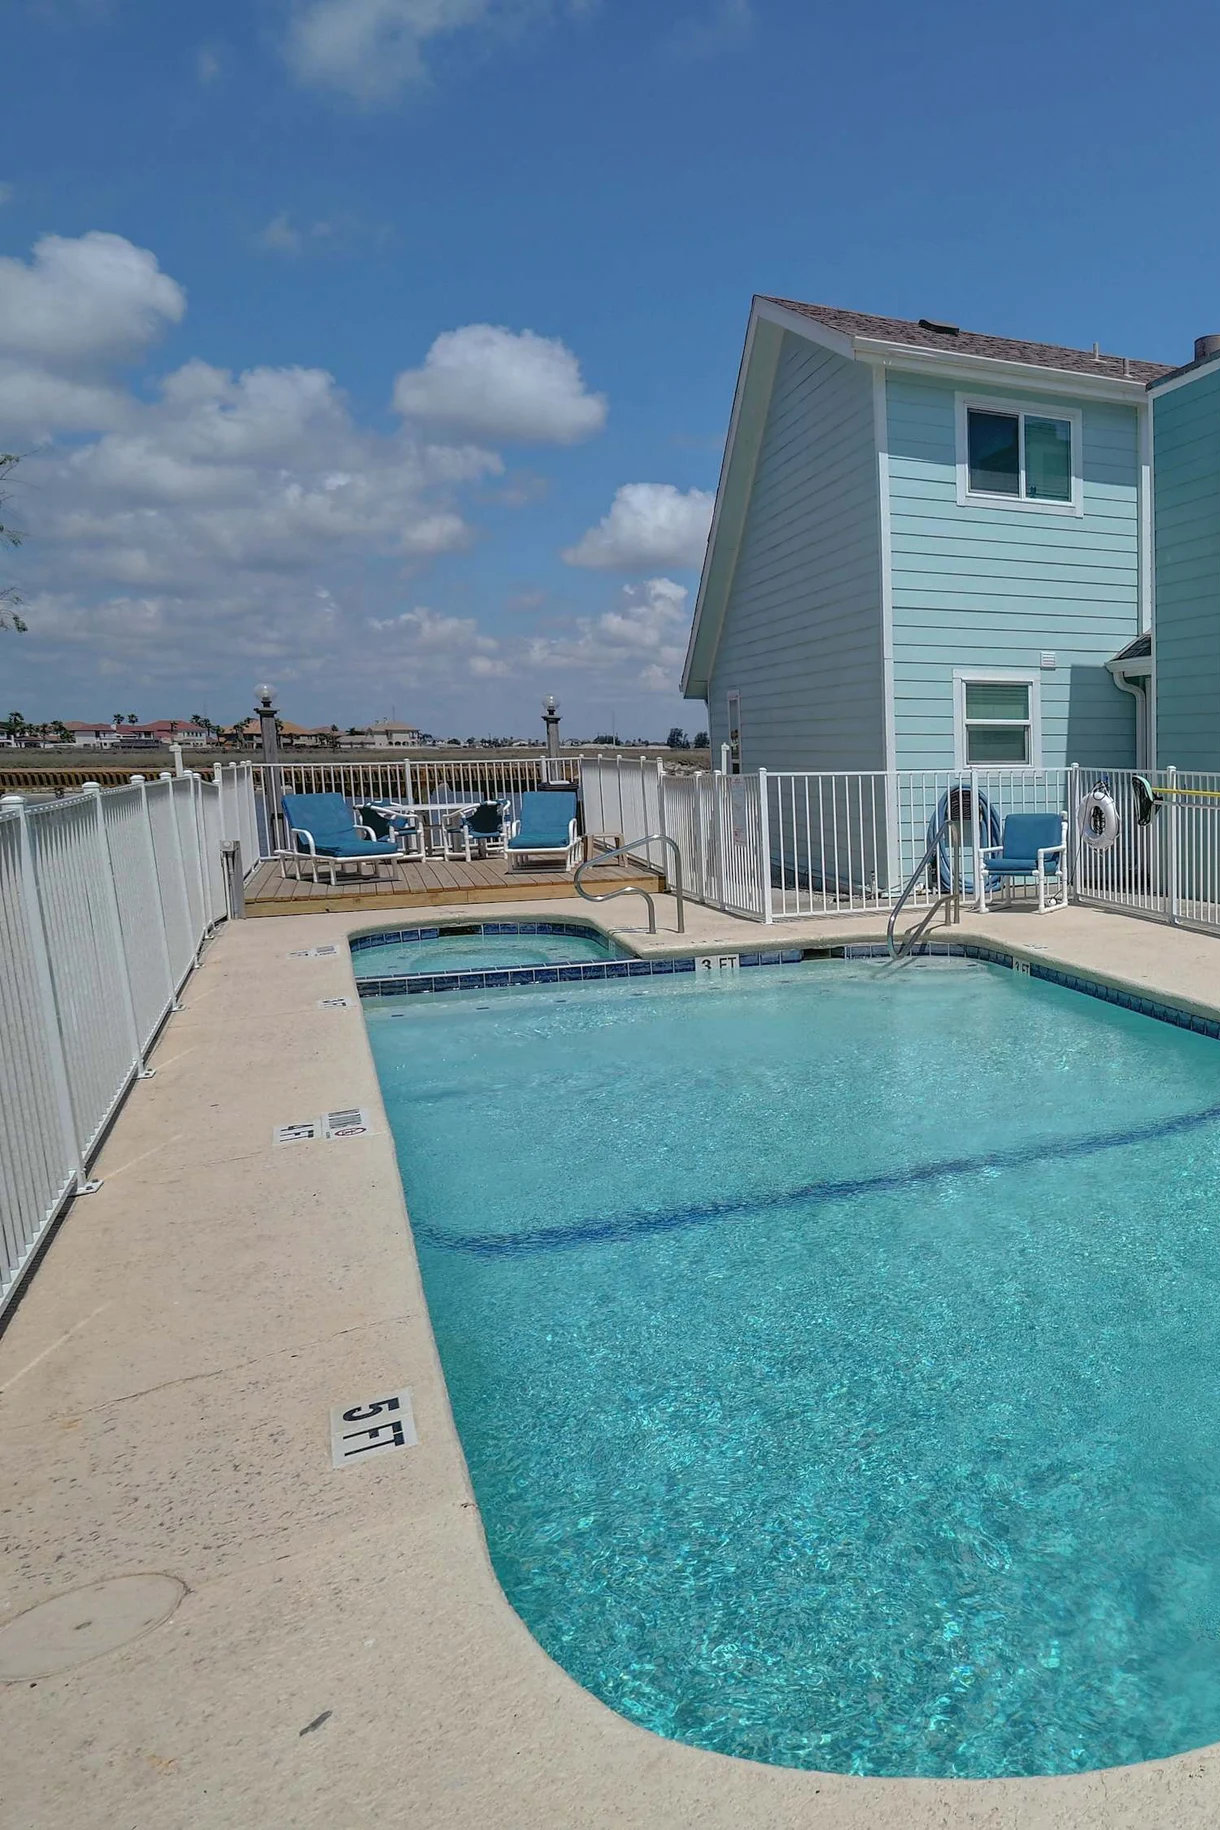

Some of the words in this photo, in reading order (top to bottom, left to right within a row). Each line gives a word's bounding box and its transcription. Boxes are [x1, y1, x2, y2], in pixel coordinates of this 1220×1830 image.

[720, 957, 736, 968] FT
[342, 1397, 400, 1422] 5
[342, 1420, 405, 1456] FT
